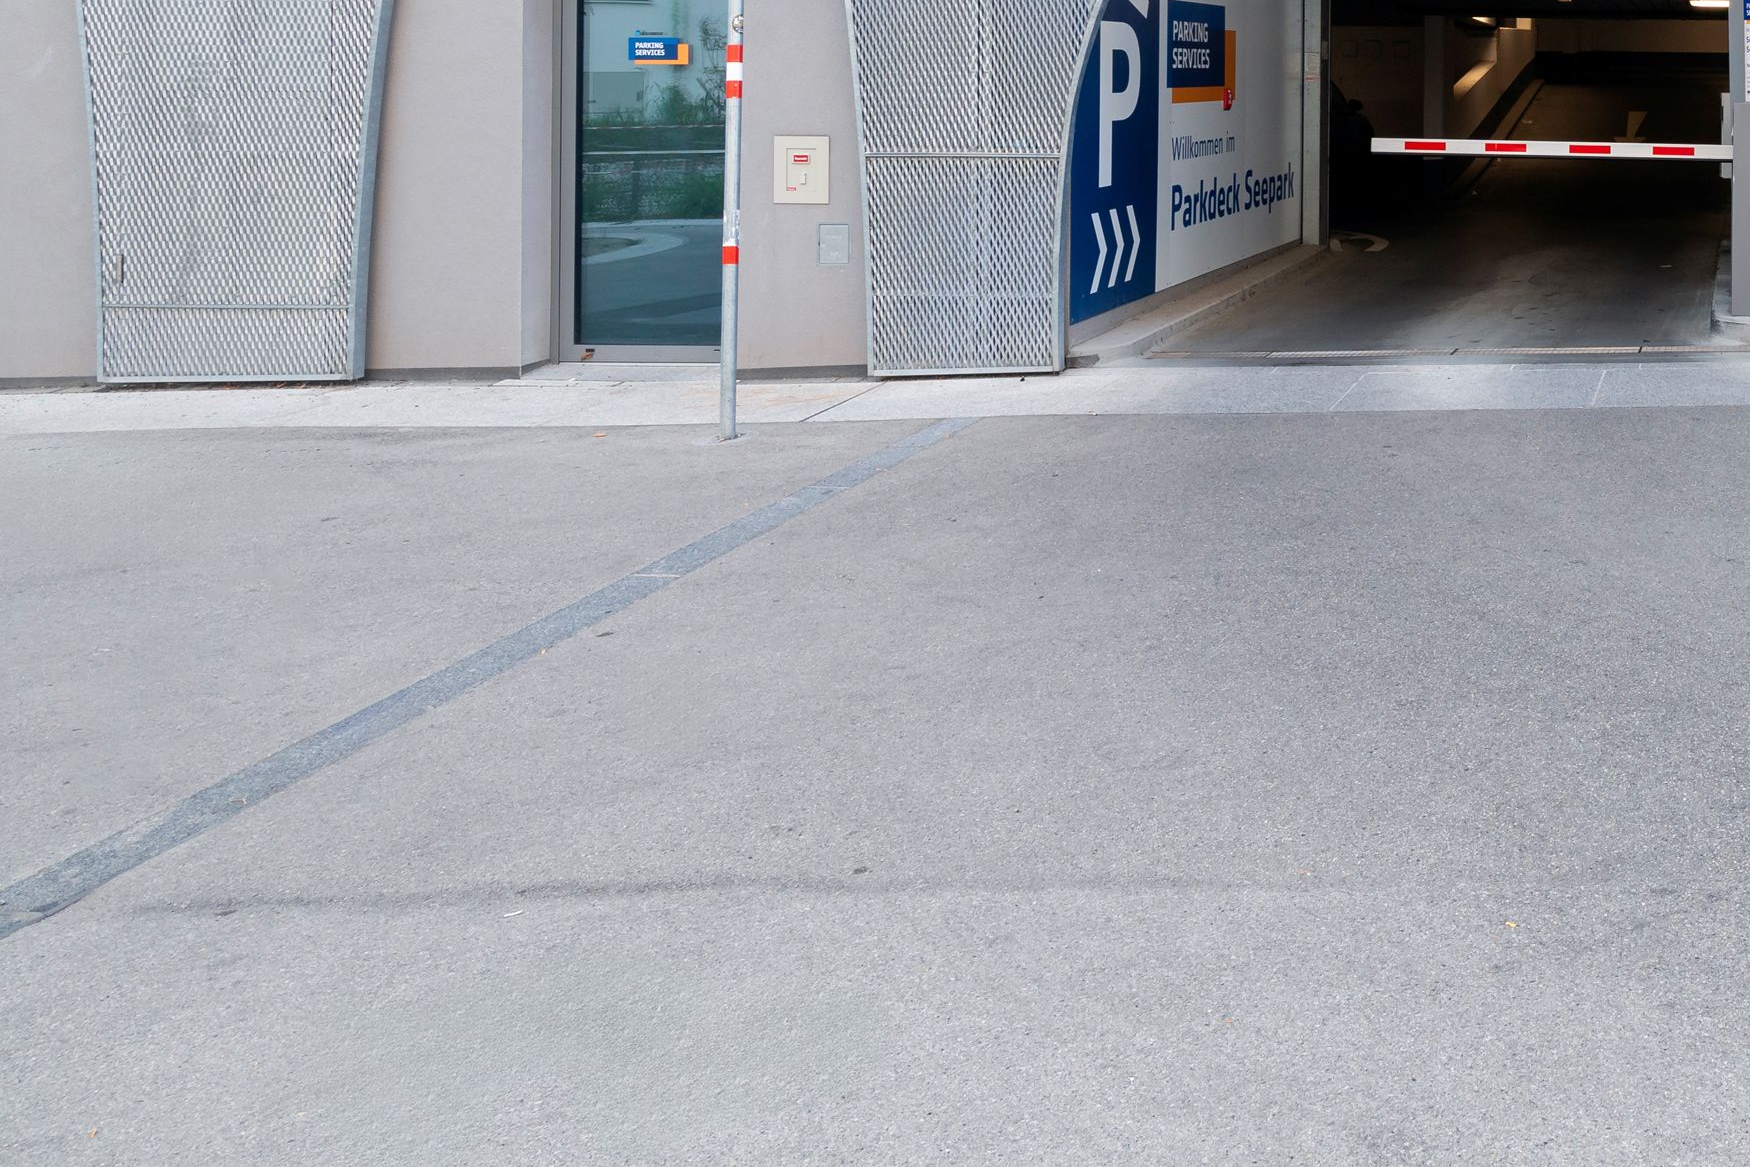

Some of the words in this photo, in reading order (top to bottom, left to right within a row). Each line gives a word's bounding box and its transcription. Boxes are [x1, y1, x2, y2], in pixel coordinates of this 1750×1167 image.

[1172, 20, 1209, 43] PARKING
[1172, 47, 1210, 69] SERVICES
[1099, 20, 1141, 189] P
[1171, 135, 1224, 161] Willkommen
[1226, 131, 1235, 153] im
[1171, 172, 1241, 231] Parkdeck
[1244, 162, 1295, 213] Seepark
